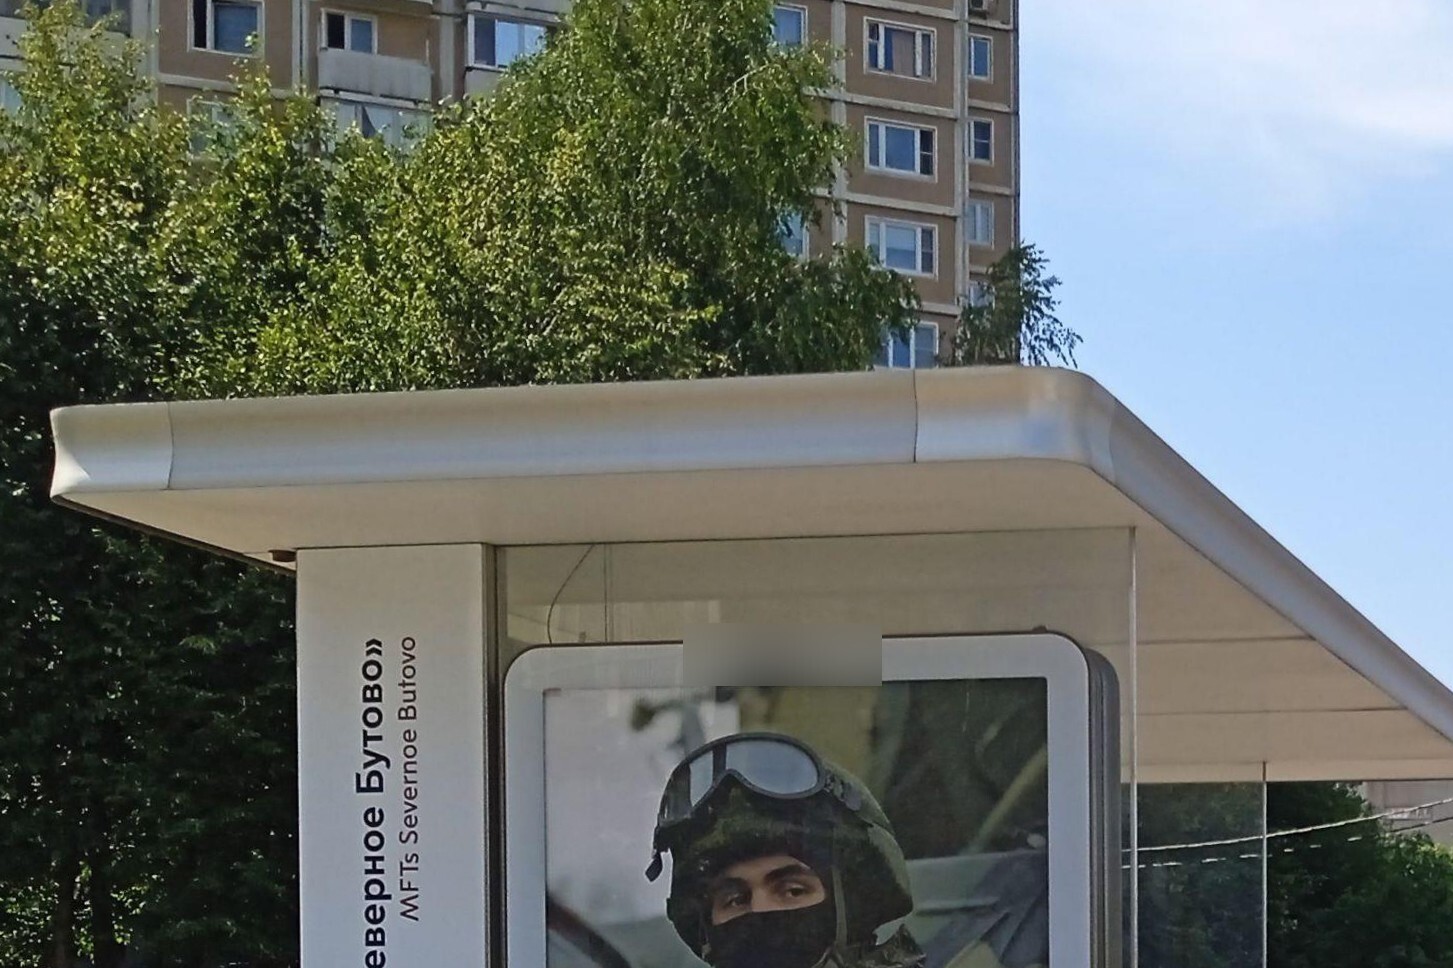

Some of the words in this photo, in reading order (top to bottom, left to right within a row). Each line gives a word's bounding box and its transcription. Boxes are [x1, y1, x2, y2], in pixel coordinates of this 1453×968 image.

[355, 638, 391, 793] Бутово»
[397, 636, 417, 721] Butovo
[398, 728, 419, 844] Severnoe
[399, 852, 420, 921] MFTs
